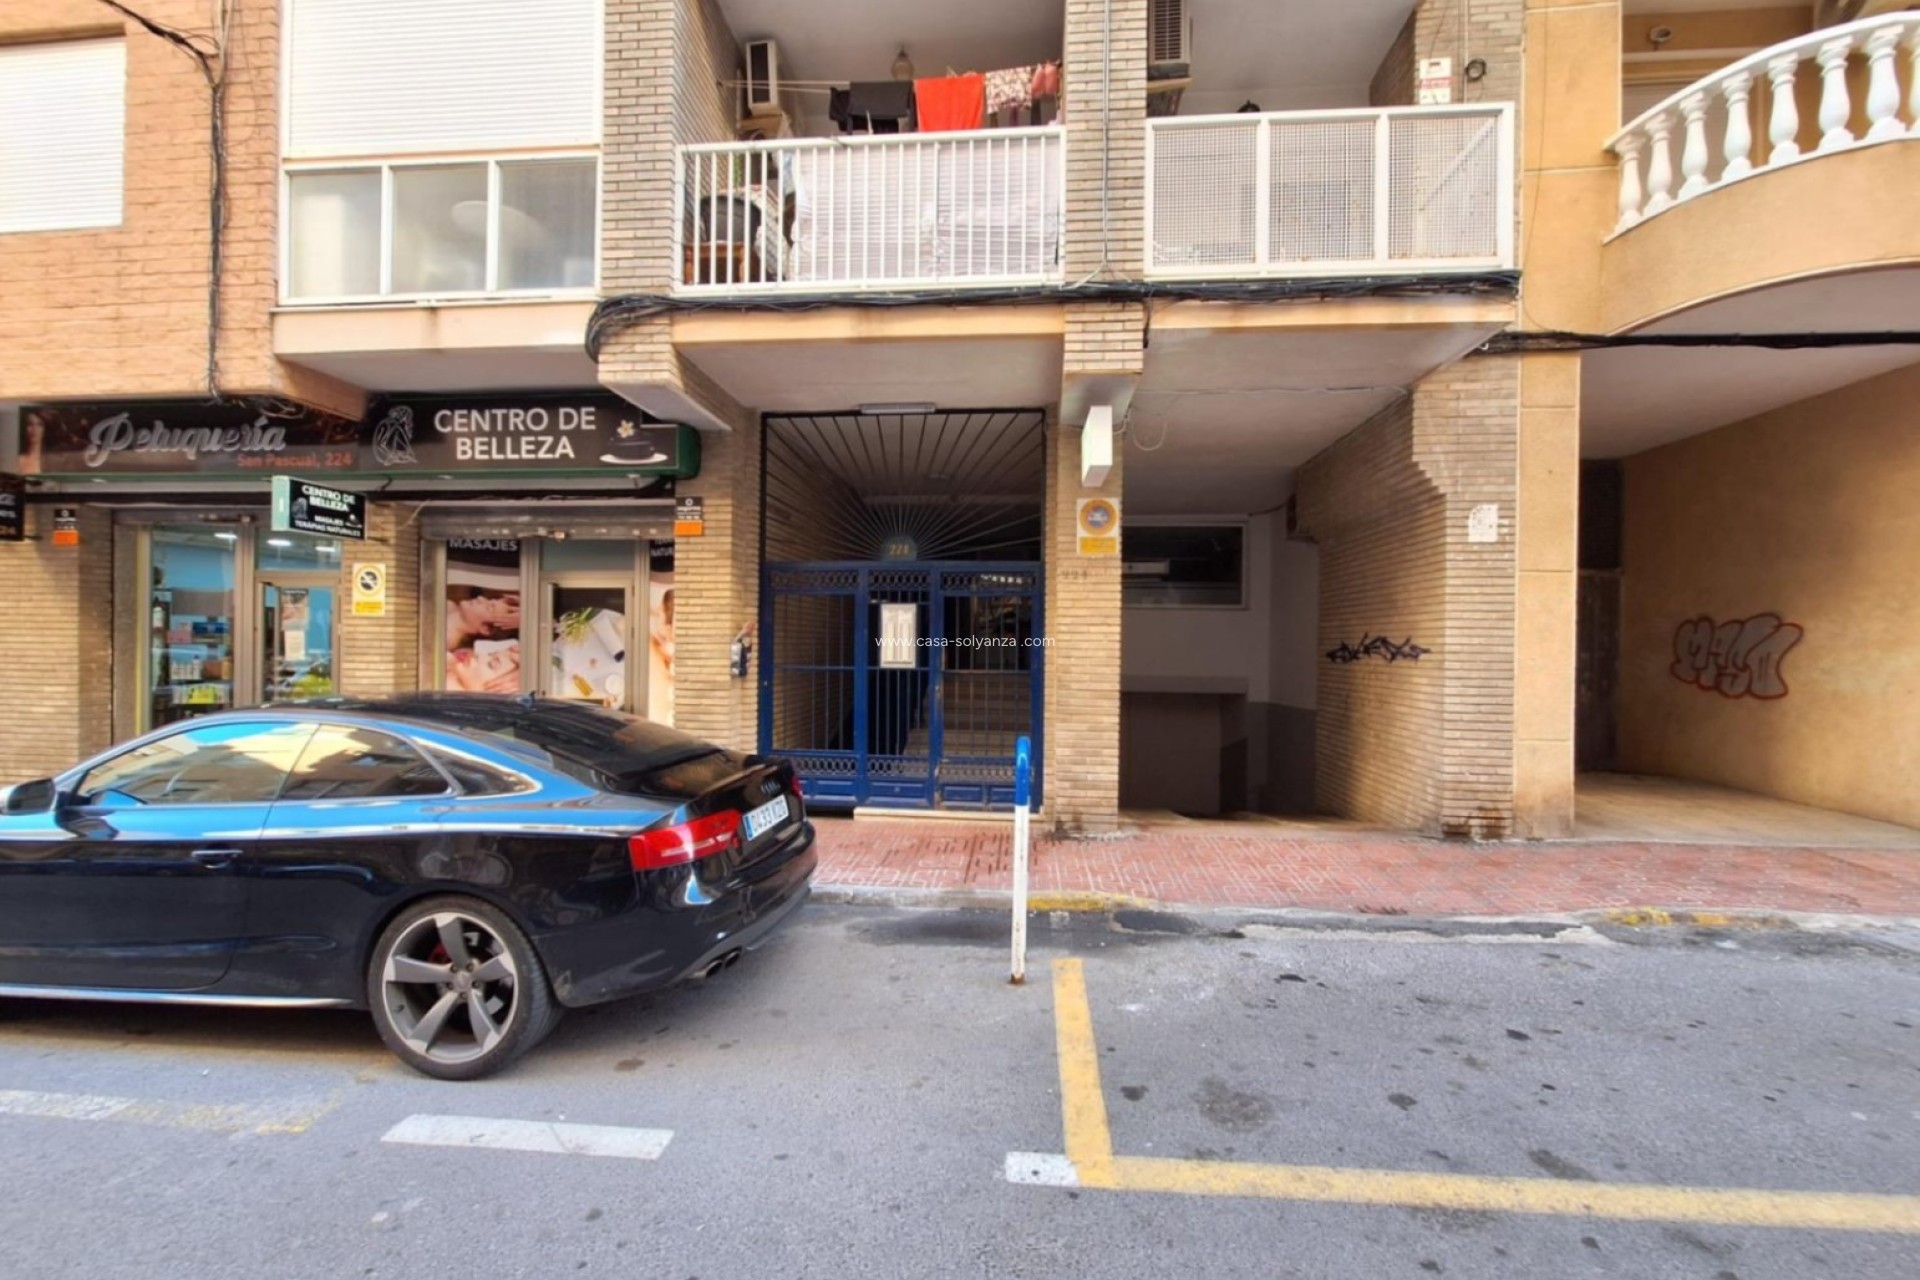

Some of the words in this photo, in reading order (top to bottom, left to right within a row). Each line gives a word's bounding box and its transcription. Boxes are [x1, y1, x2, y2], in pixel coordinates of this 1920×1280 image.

[434, 408, 549, 433] CENTRO
[558, 407, 596, 431] DE
[84, 412, 287, 467] Peluquería
[456, 436, 575, 460] BELLEZA
[237, 453, 262, 467] San
[324, 452, 352, 466] 224
[302, 485, 341, 500] CENTRO
[343, 493, 356, 504] DE
[310, 495, 349, 511] BELLEZA
[449, 538, 518, 551] MASAJES
